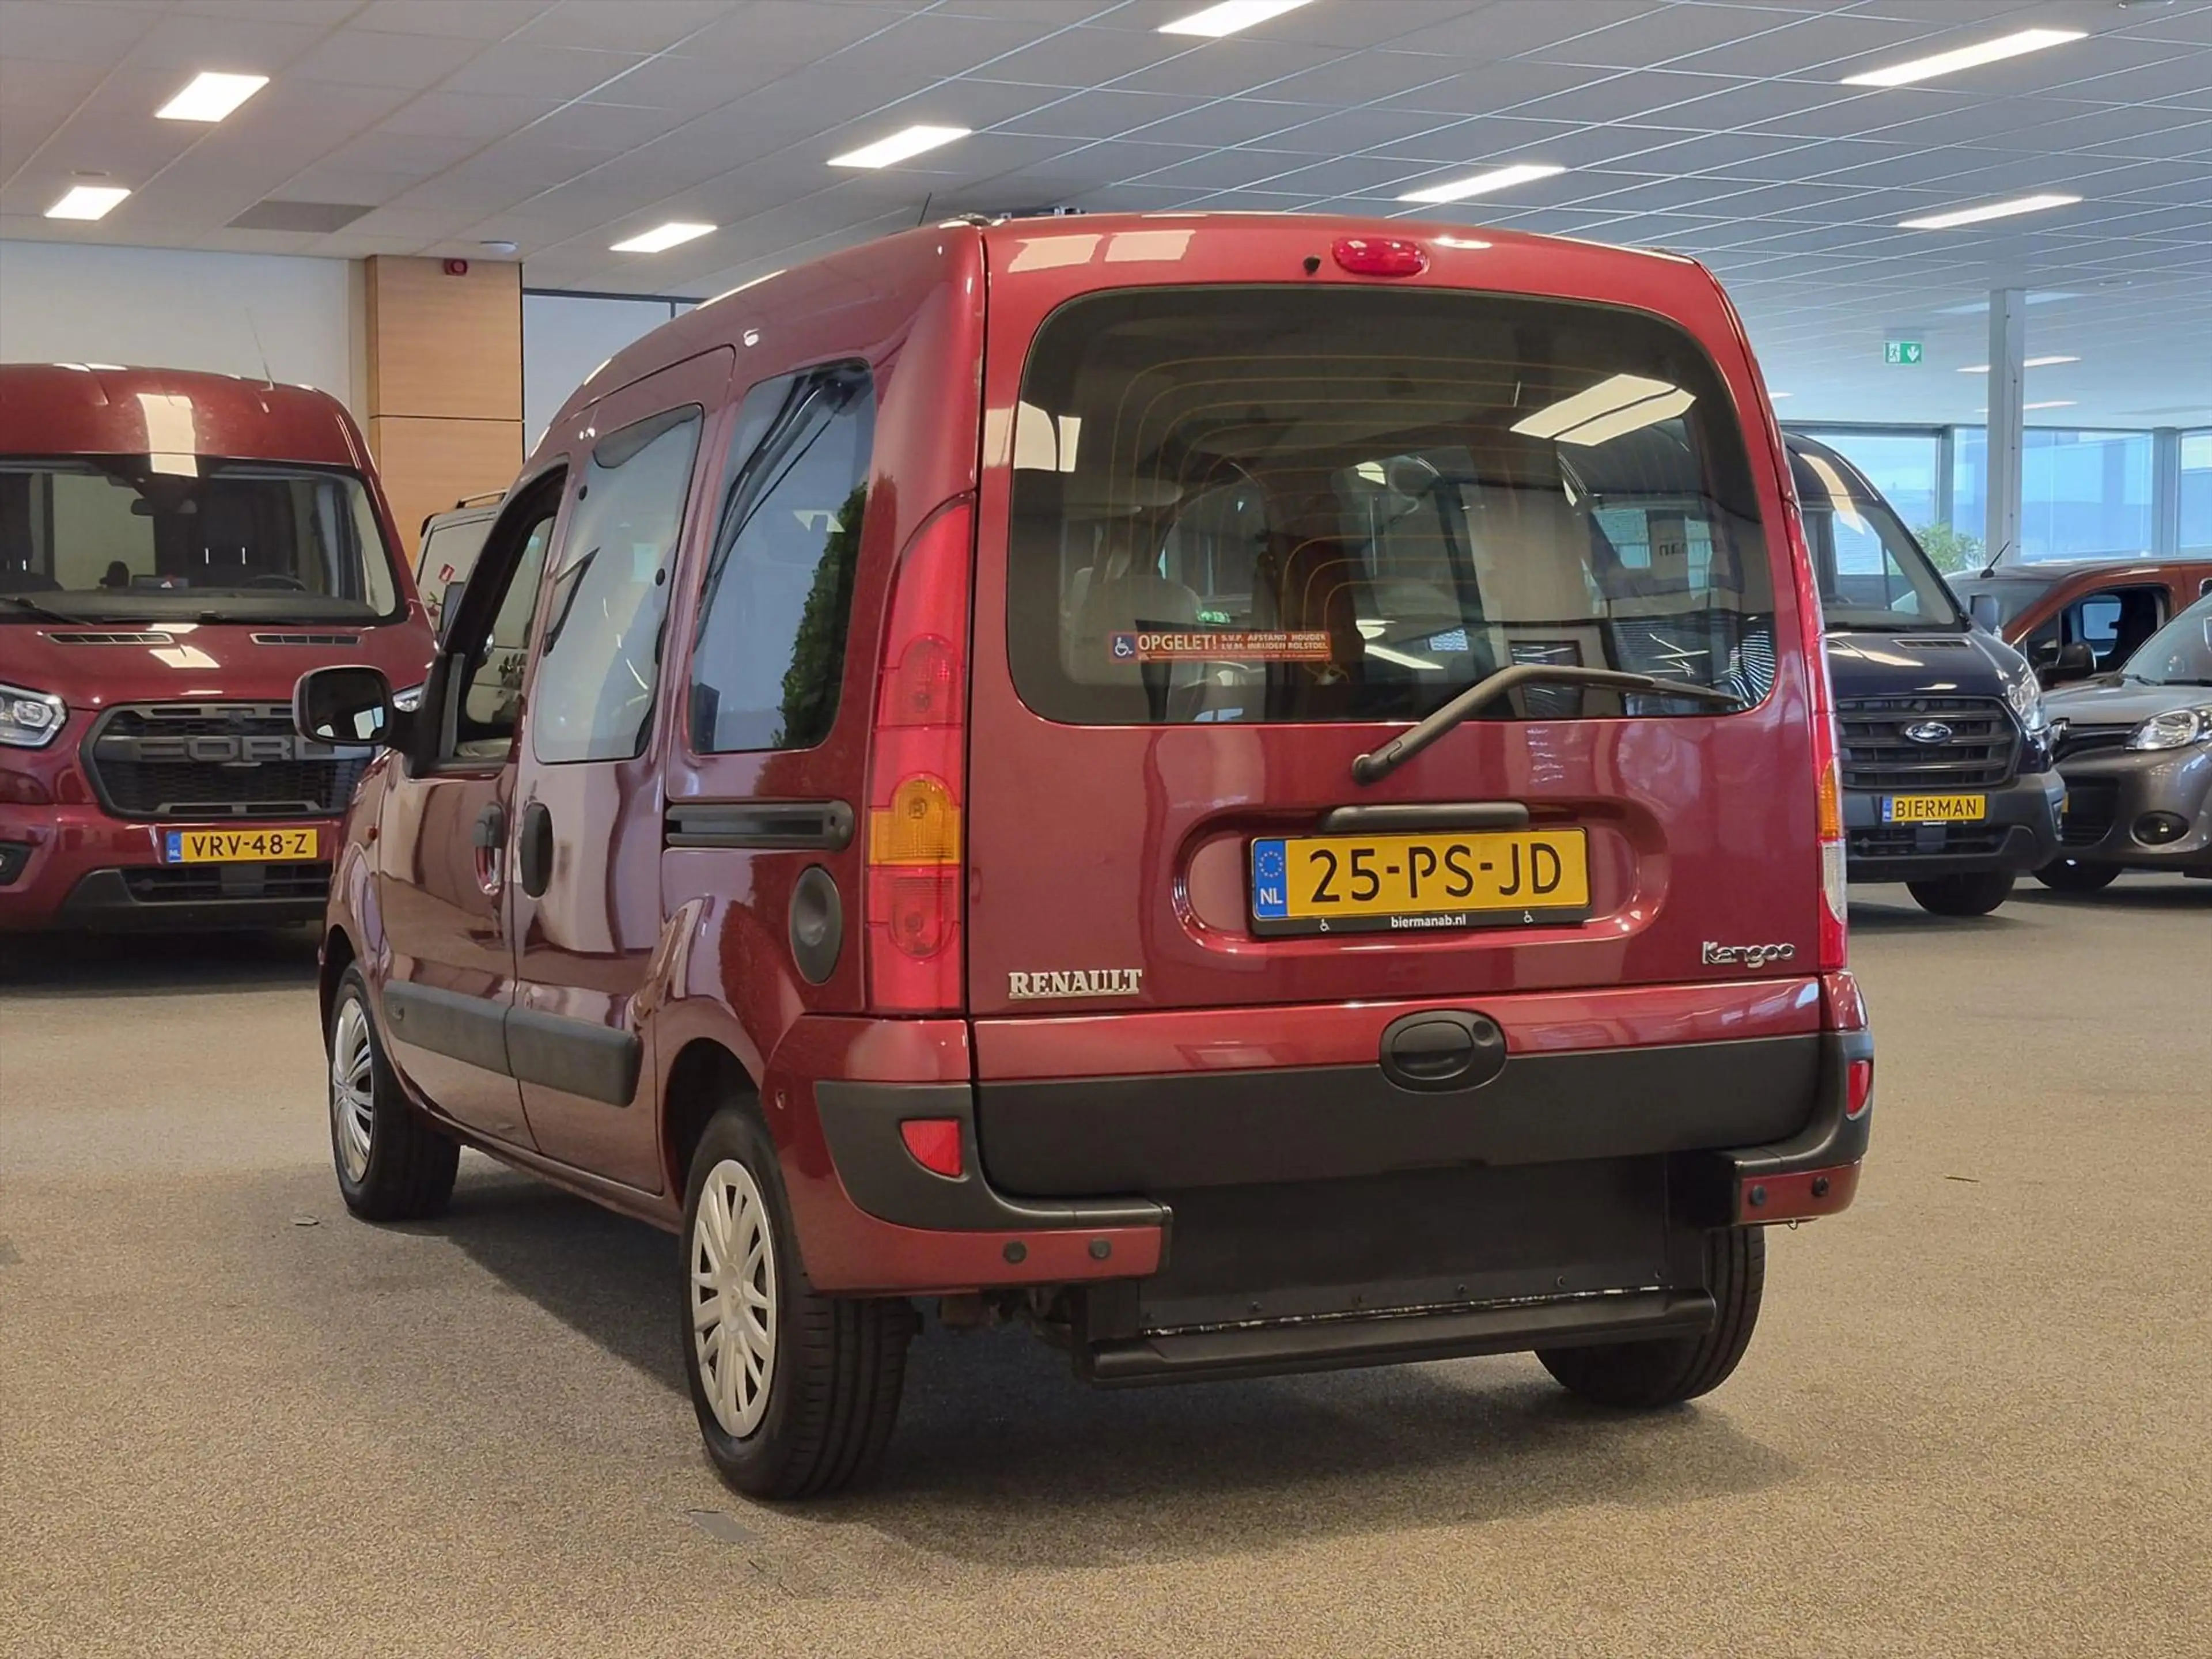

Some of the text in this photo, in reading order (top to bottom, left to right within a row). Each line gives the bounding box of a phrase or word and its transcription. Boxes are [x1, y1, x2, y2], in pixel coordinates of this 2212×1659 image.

[1138, 635, 1217, 650] OPGELET!
[1896, 799, 1976, 817] BIERMAN
[191, 834, 307, 857] VRV-48-Z
[1309, 843, 1562, 903] 25-PS-JD
[1260, 888, 1283, 905] NL
[1391, 913, 1467, 929] biermanab.nl
[1702, 941, 1795, 968] Kangoo
[1008, 969, 1142, 998] RENAULT
